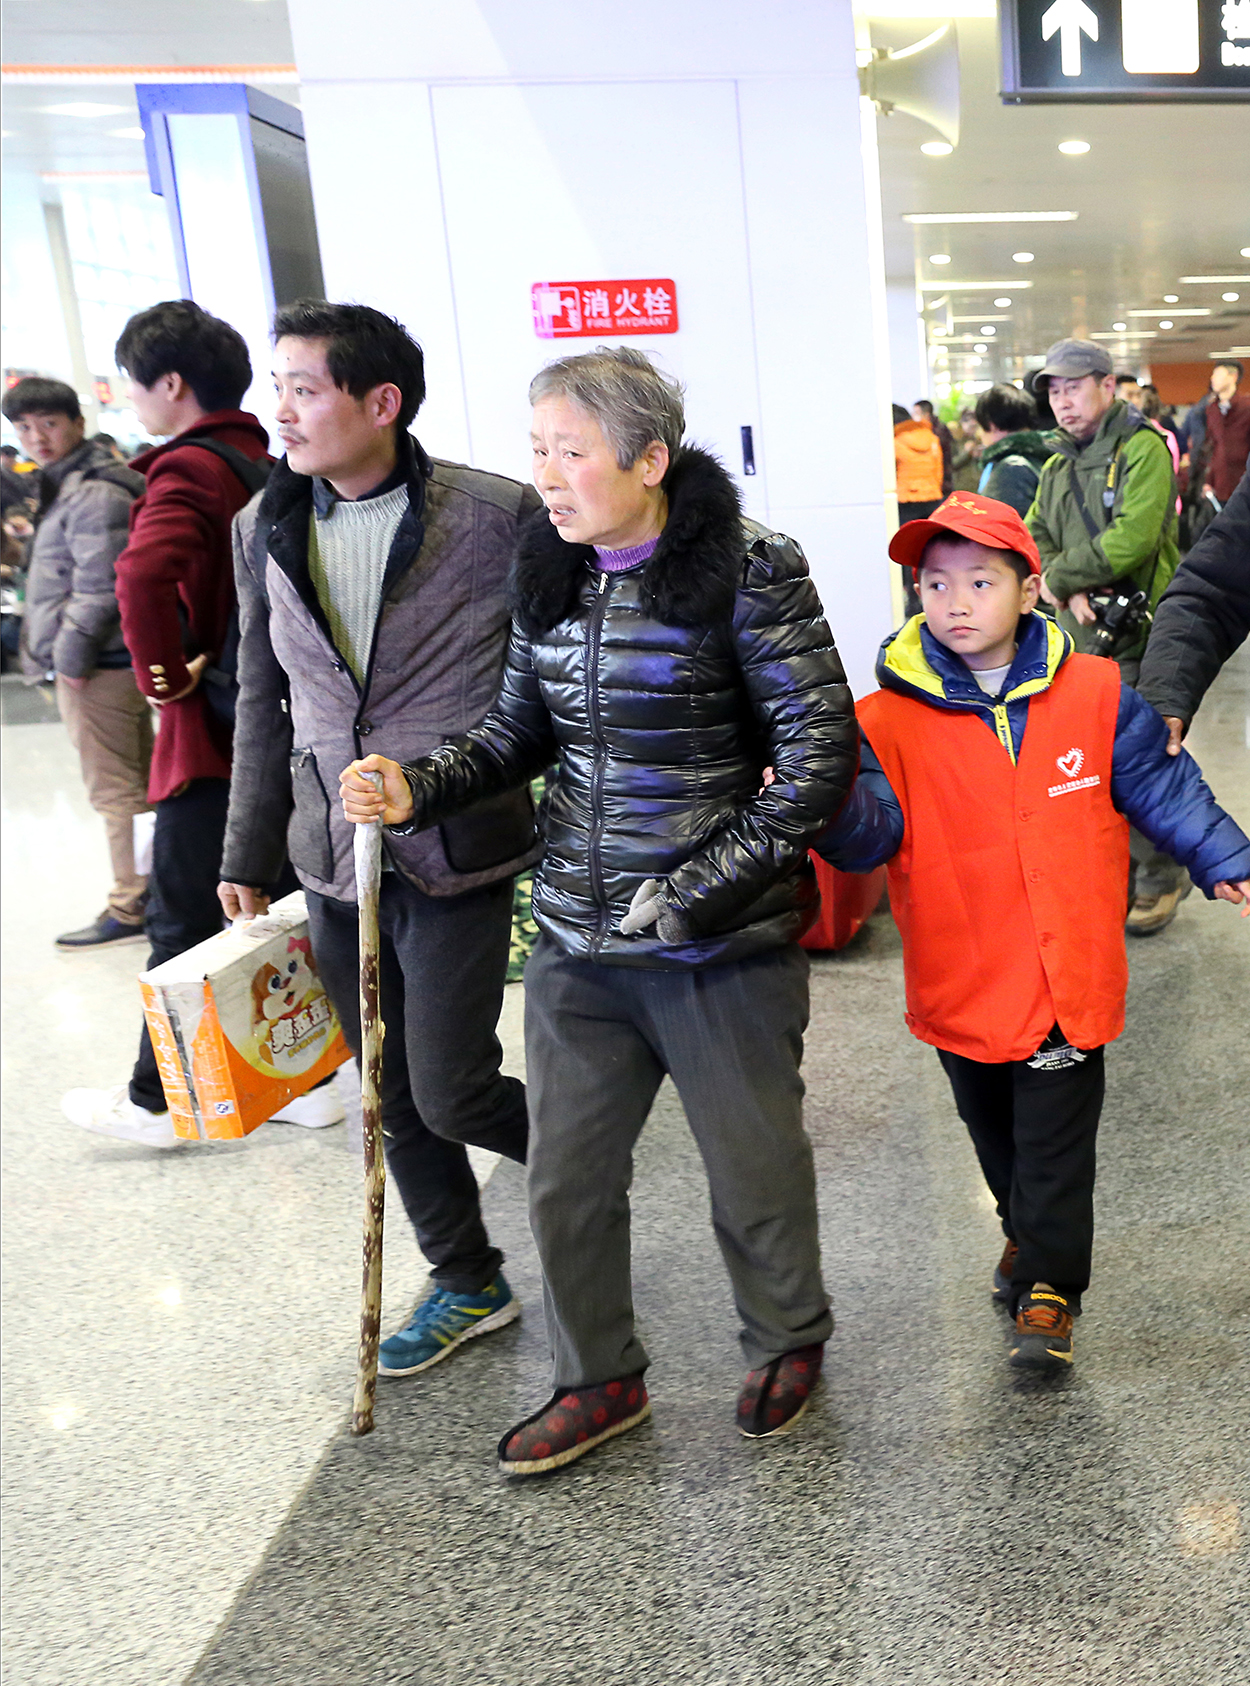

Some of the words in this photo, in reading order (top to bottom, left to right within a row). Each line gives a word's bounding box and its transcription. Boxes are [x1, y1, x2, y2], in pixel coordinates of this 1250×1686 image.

[582, 286, 673, 318] 消火栓
[586, 317, 613, 330] FIRE
[616, 315, 670, 329] HYDRANT
